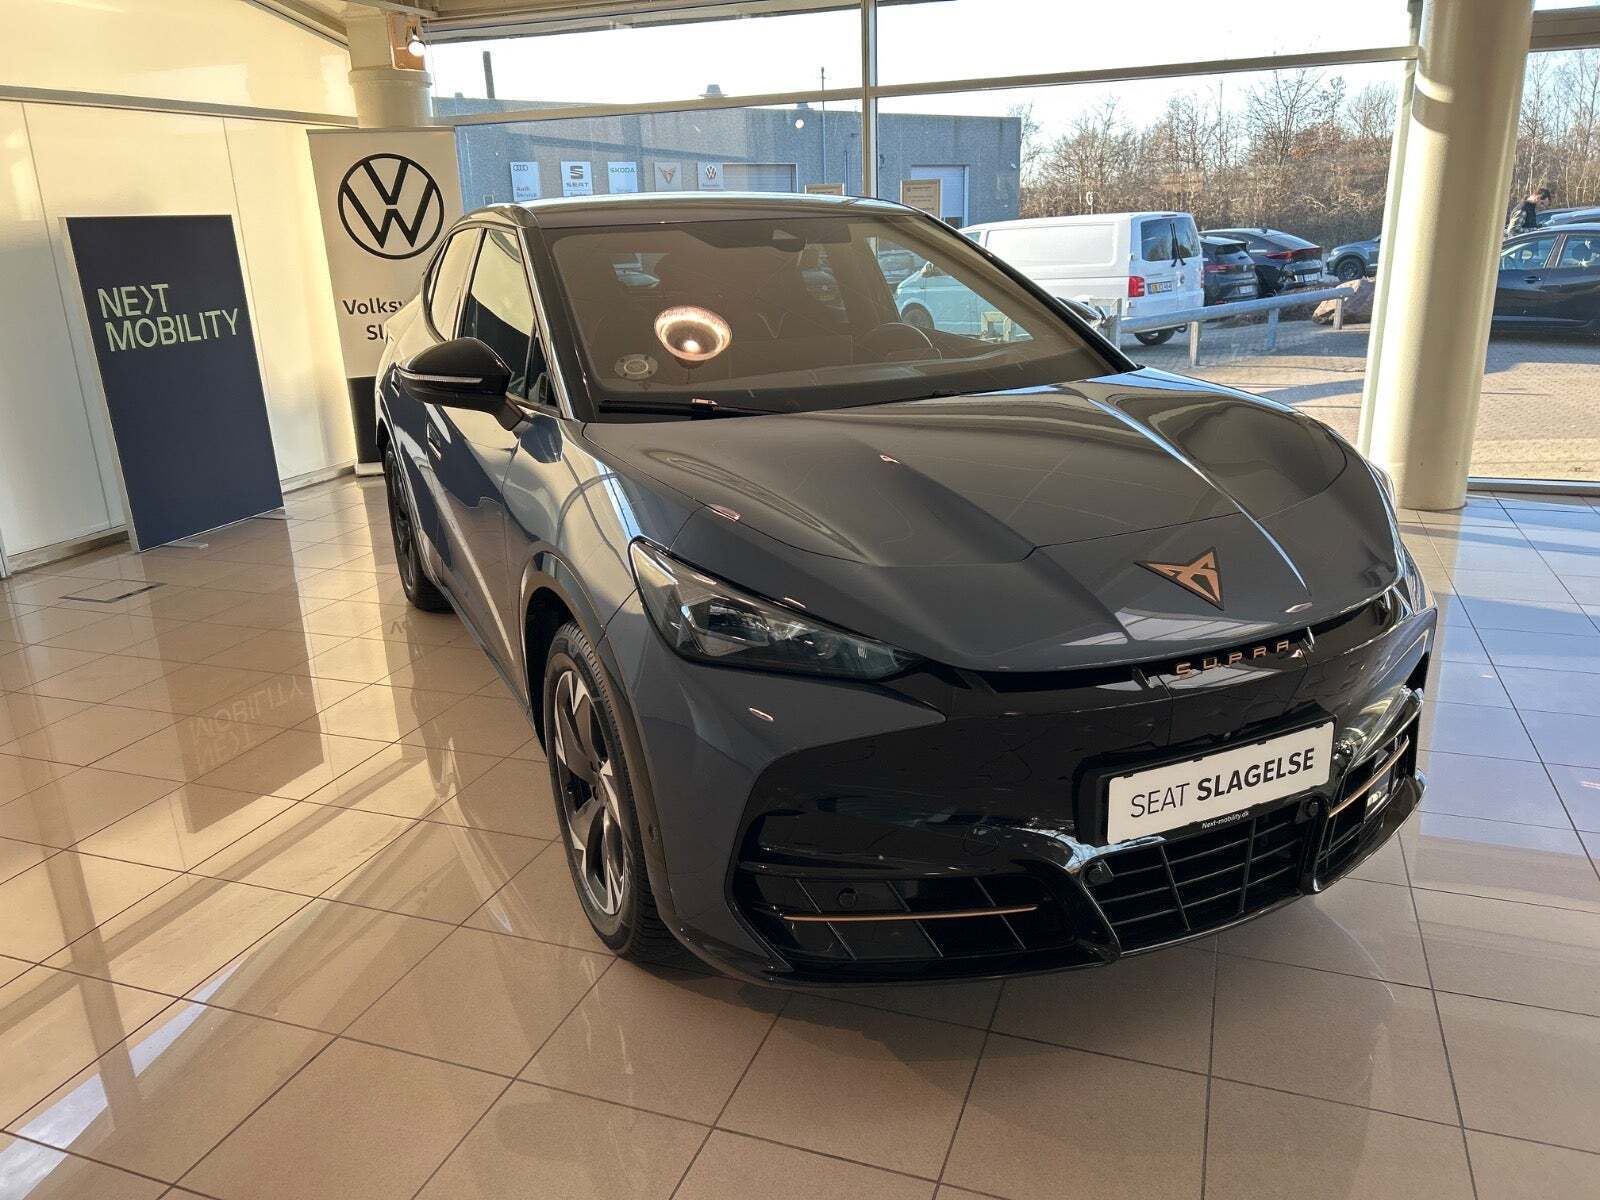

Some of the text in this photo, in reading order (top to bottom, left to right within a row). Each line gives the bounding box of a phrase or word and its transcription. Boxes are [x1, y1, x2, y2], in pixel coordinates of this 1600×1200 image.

[104, 307, 238, 353] MOBILITY
[366, 324, 385, 342] Sl
[1130, 747, 1315, 818] SEAT SLAGELSE
